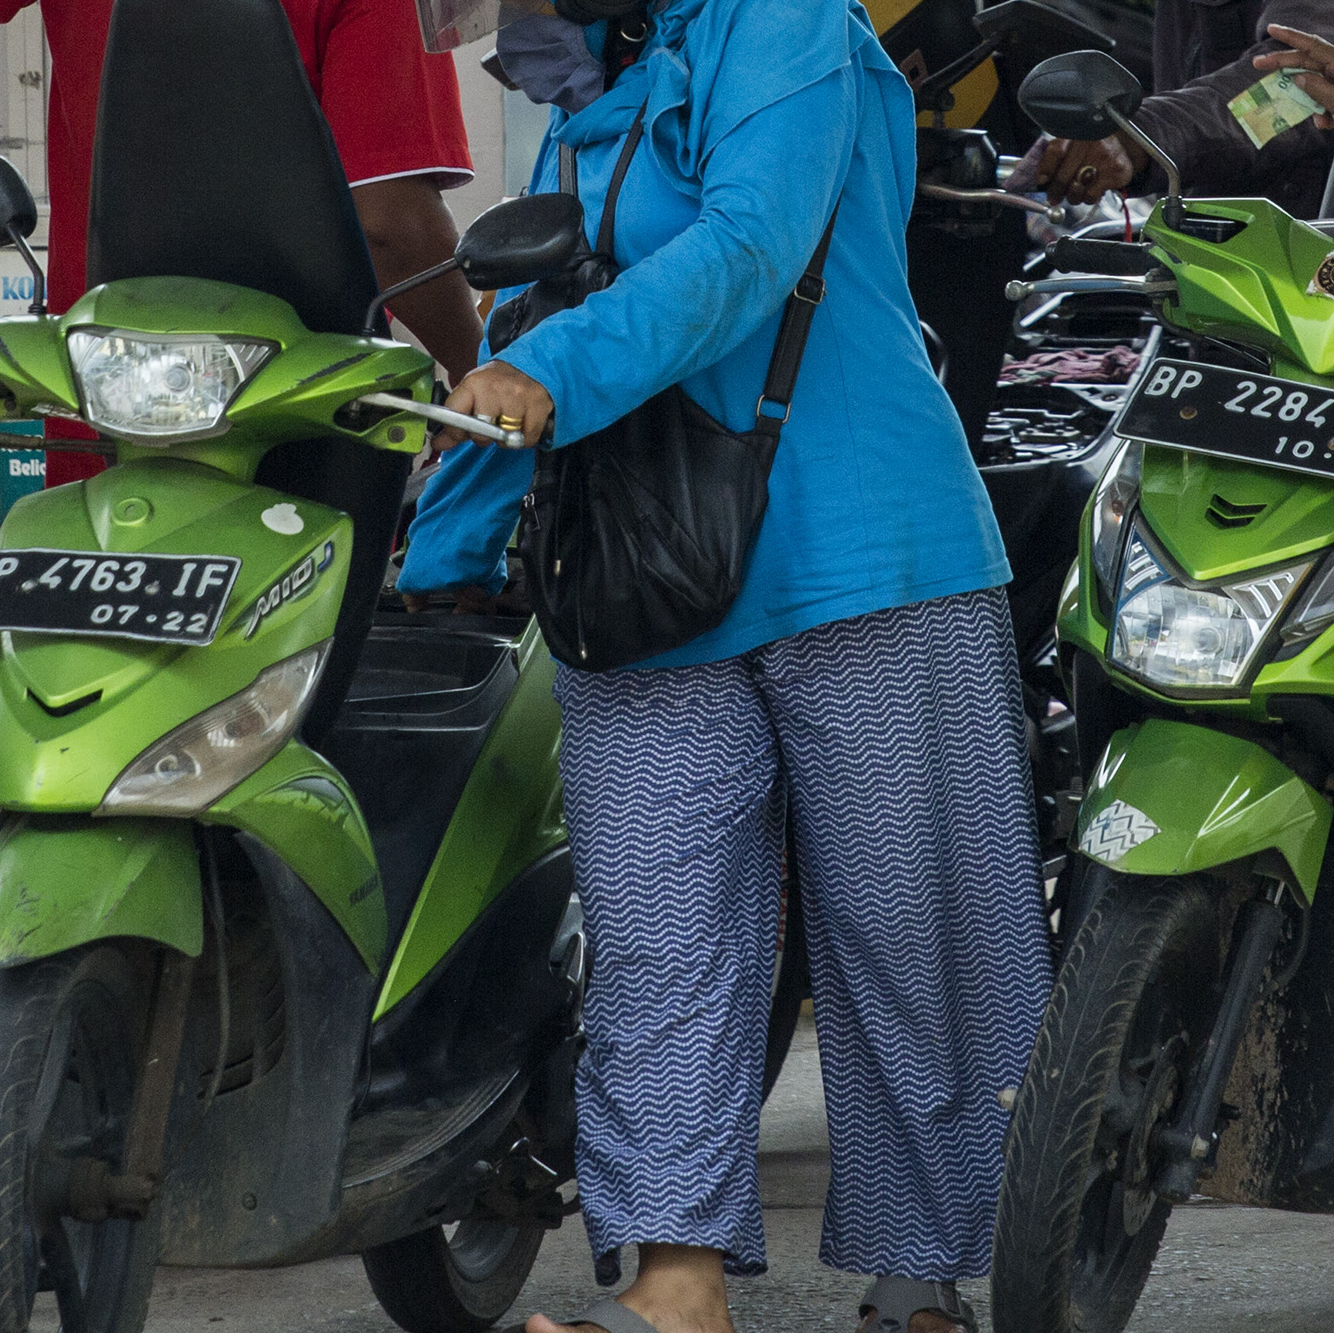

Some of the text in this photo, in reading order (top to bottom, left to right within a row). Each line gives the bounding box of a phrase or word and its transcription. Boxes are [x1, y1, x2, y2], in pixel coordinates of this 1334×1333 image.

[2, 276, 47, 300] KO
[1144, 366, 1203, 399] BP
[1224, 381, 1334, 428] 2284
[39, 558, 147, 592] 4763
[172, 563, 228, 598] IF
